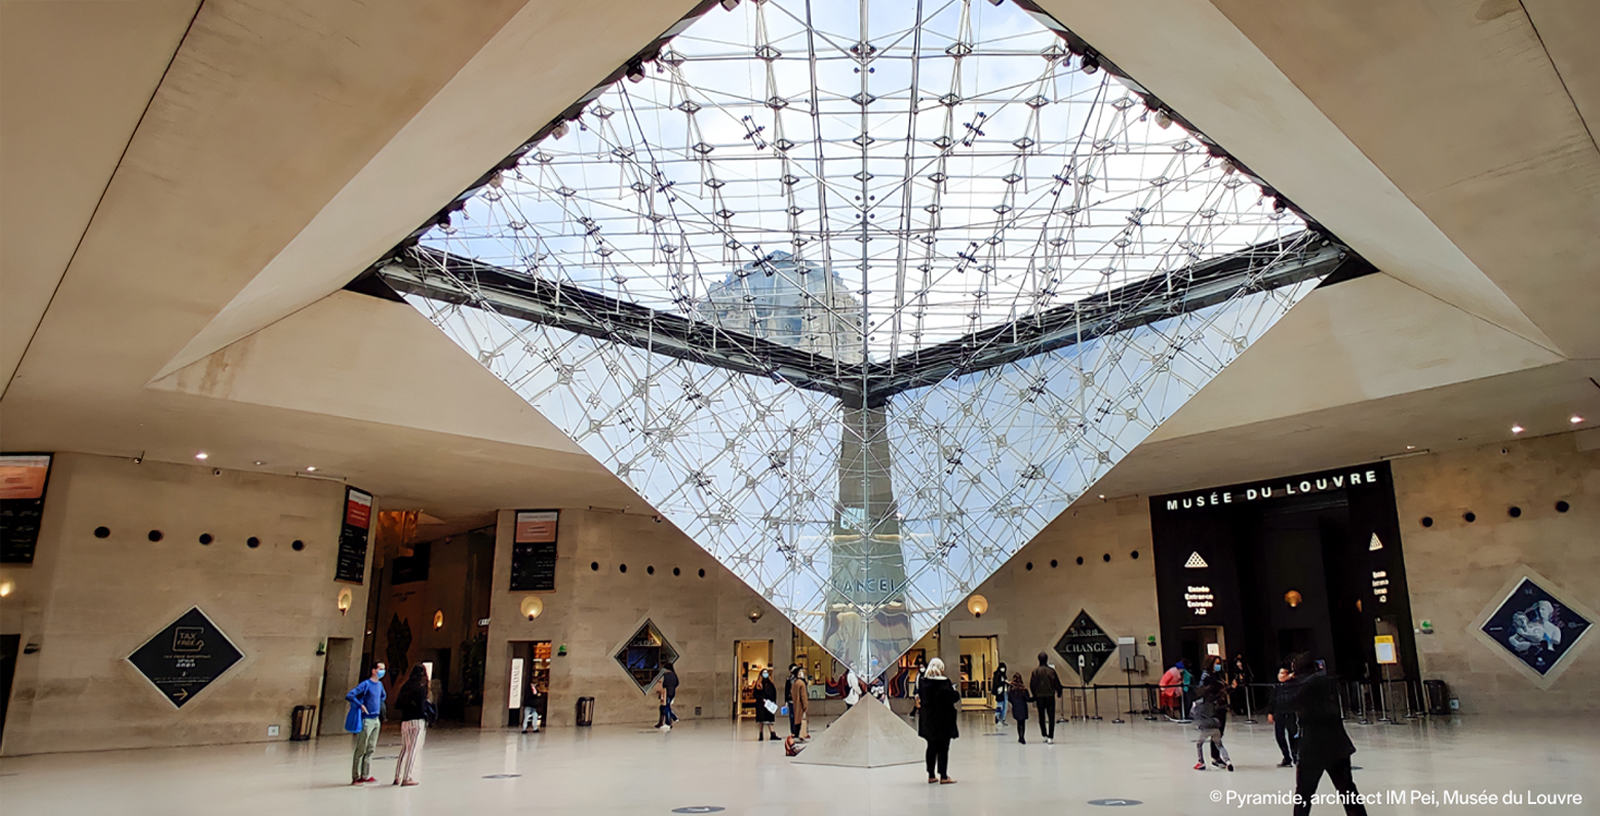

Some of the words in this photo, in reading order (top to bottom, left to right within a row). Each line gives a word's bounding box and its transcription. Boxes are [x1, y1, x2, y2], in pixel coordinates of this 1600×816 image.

[1166, 491, 1233, 511] MUSÉE
[1246, 486, 1273, 501] DU
[1286, 470, 1377, 495] LOUVRE
[1065, 642, 1108, 653] CHANGE
